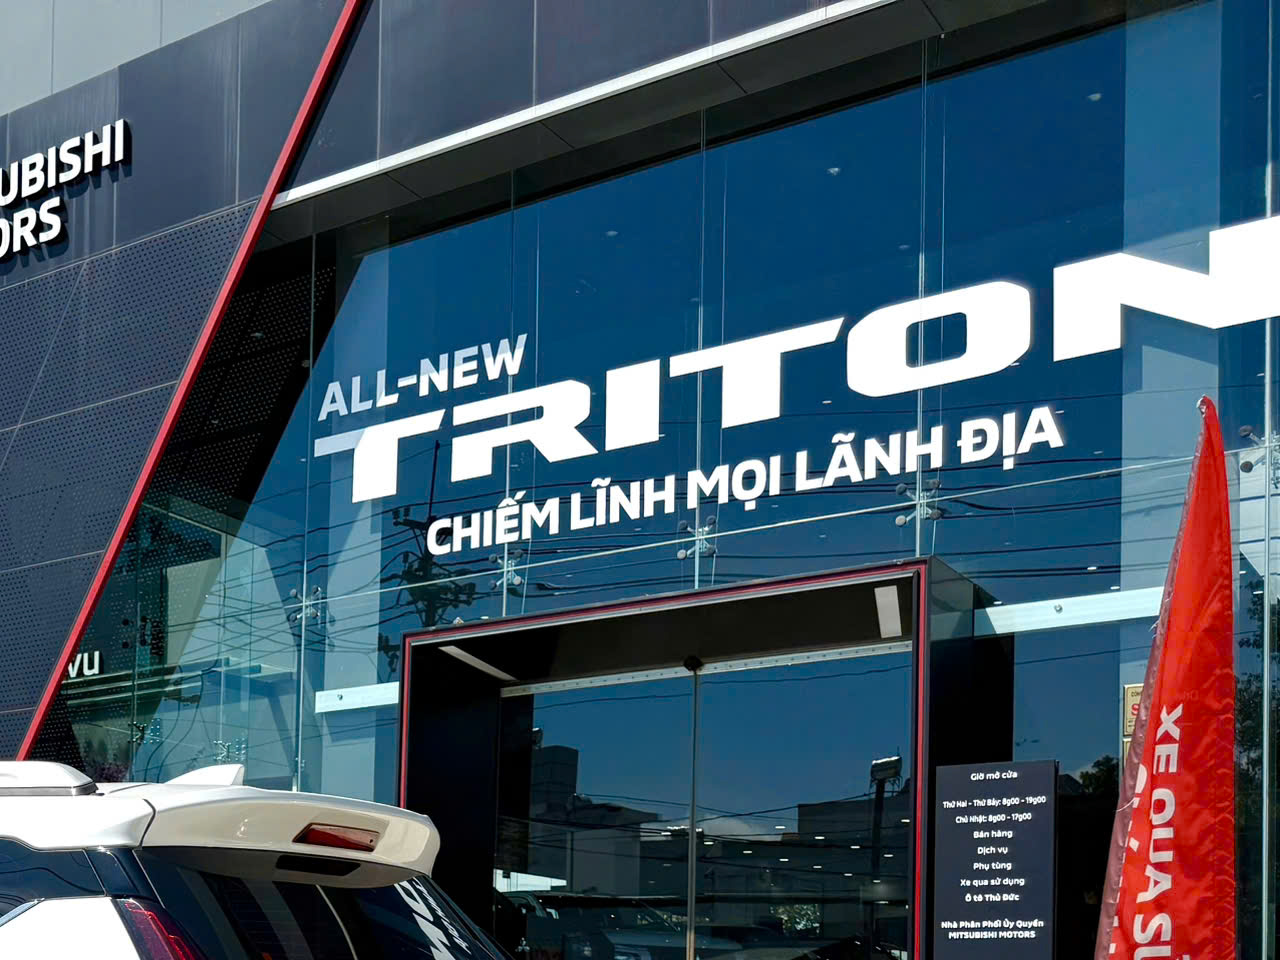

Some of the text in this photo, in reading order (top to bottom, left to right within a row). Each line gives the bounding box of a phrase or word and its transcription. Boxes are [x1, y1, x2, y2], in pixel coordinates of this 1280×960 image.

[313, 214, 1280, 504] TRITON
[317, 333, 528, 422] ALL-NEW
[426, 405, 1063, 556] CHIẾM LĨNH MỌI LÃNH ĐỊA
[1153, 703, 1184, 775] XE
[960, 879, 971, 887] Xe
[972, 879, 989, 887] qua
[977, 846, 996, 855] Dịch
[1136, 788, 1176, 904] QUA
[948, 931, 1036, 939] MITSUBISHI MOTORS
